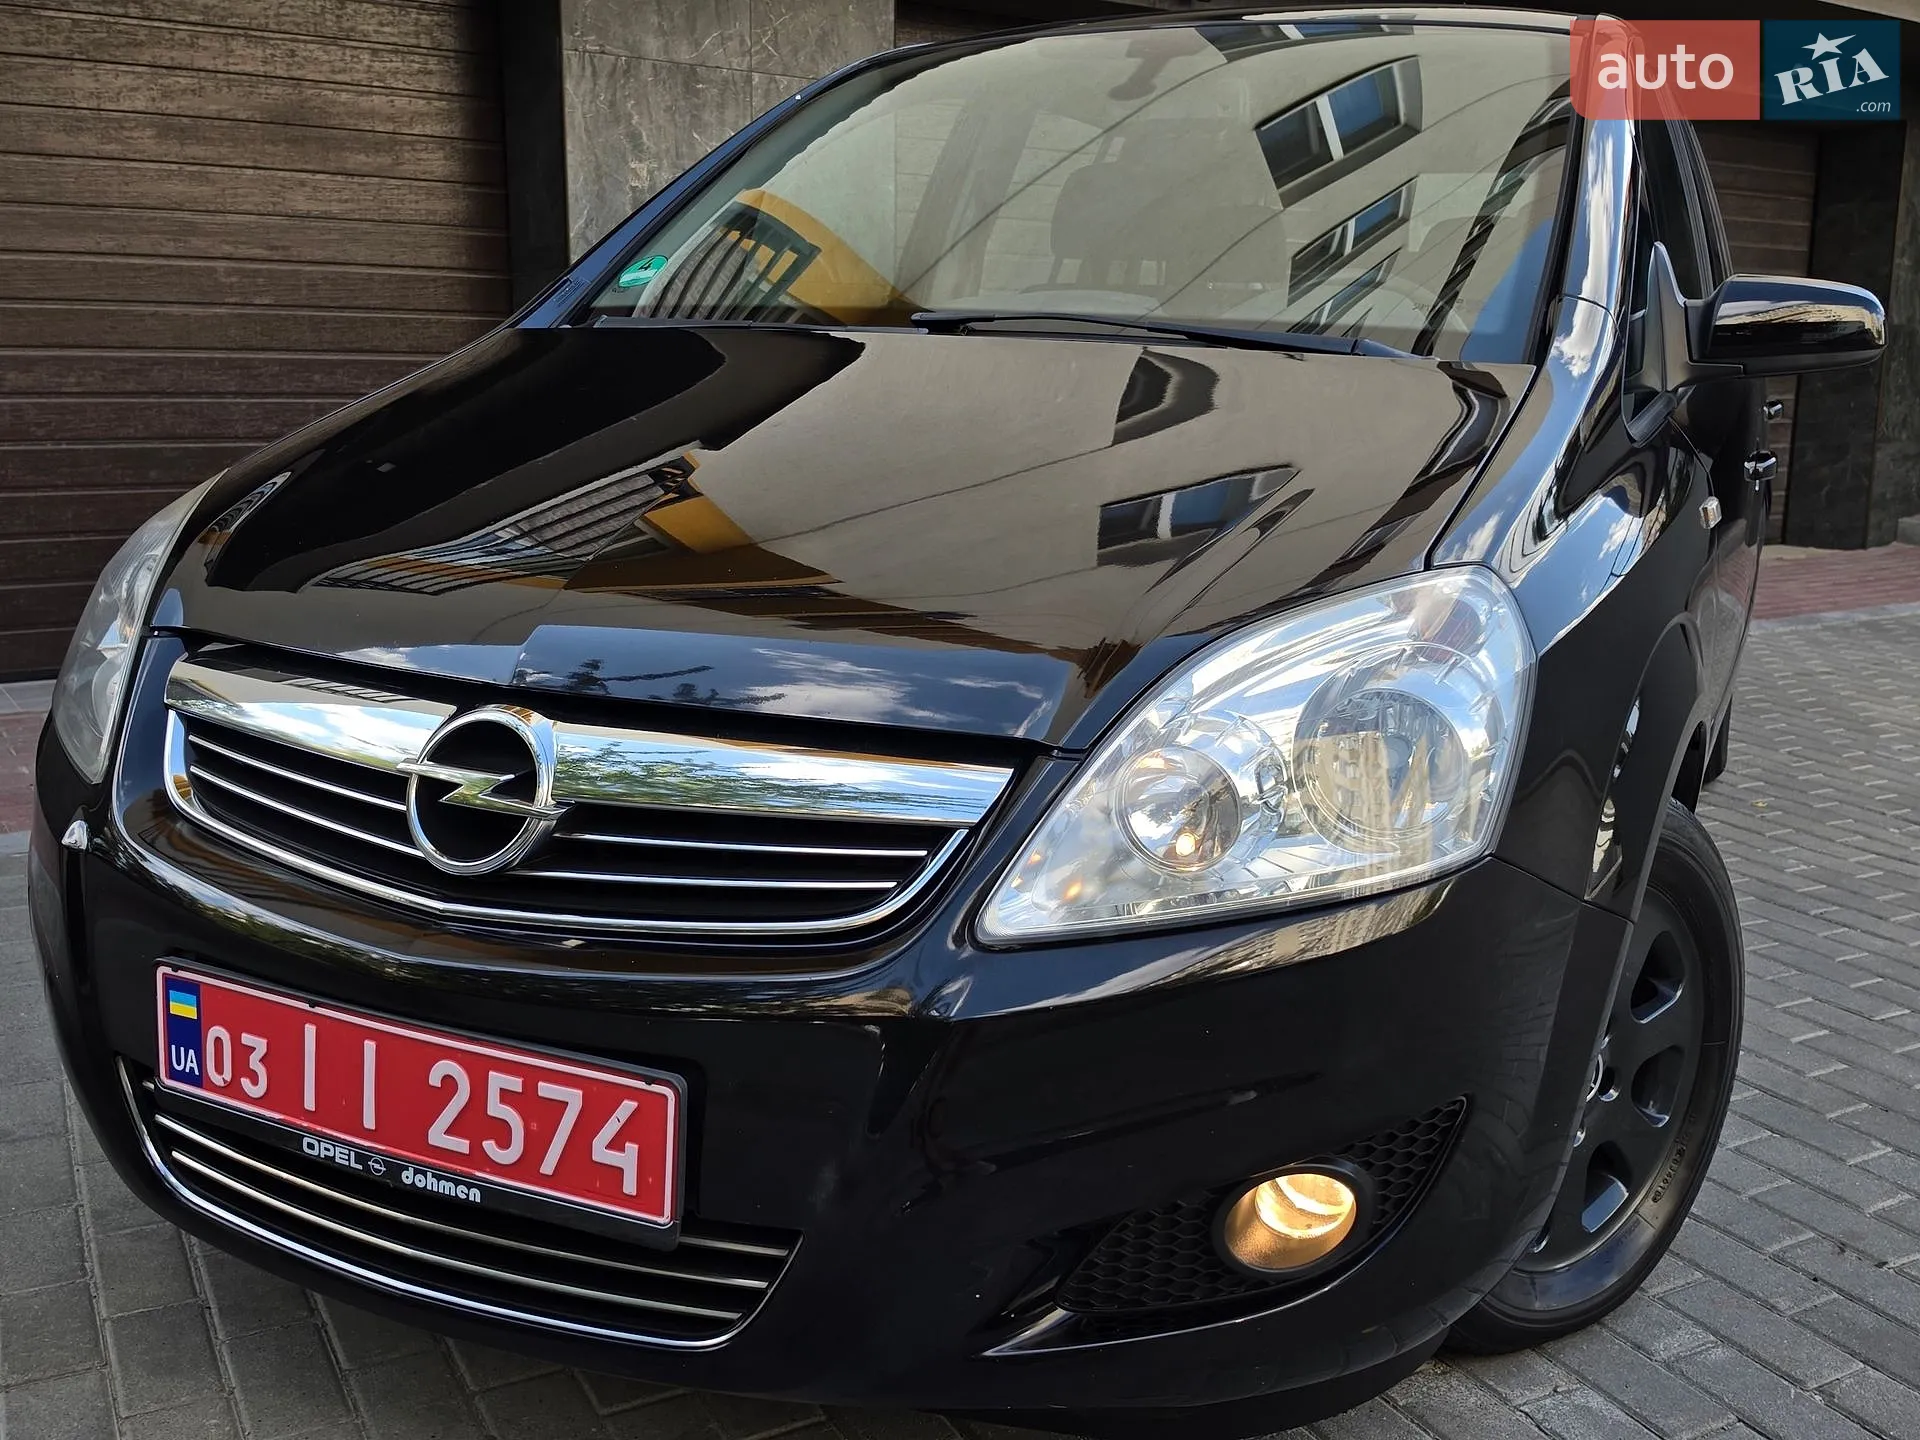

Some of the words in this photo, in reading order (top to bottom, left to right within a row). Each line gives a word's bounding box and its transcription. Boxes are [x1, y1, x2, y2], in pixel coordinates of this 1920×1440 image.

[638, 257, 655, 271] 4
[171, 1044, 199, 1076] UA
[206, 1025, 268, 1099] 03
[428, 1060, 639, 1196] 2574
[302, 1136, 363, 1171] OPEL
[401, 1166, 481, 1203] dohmen
